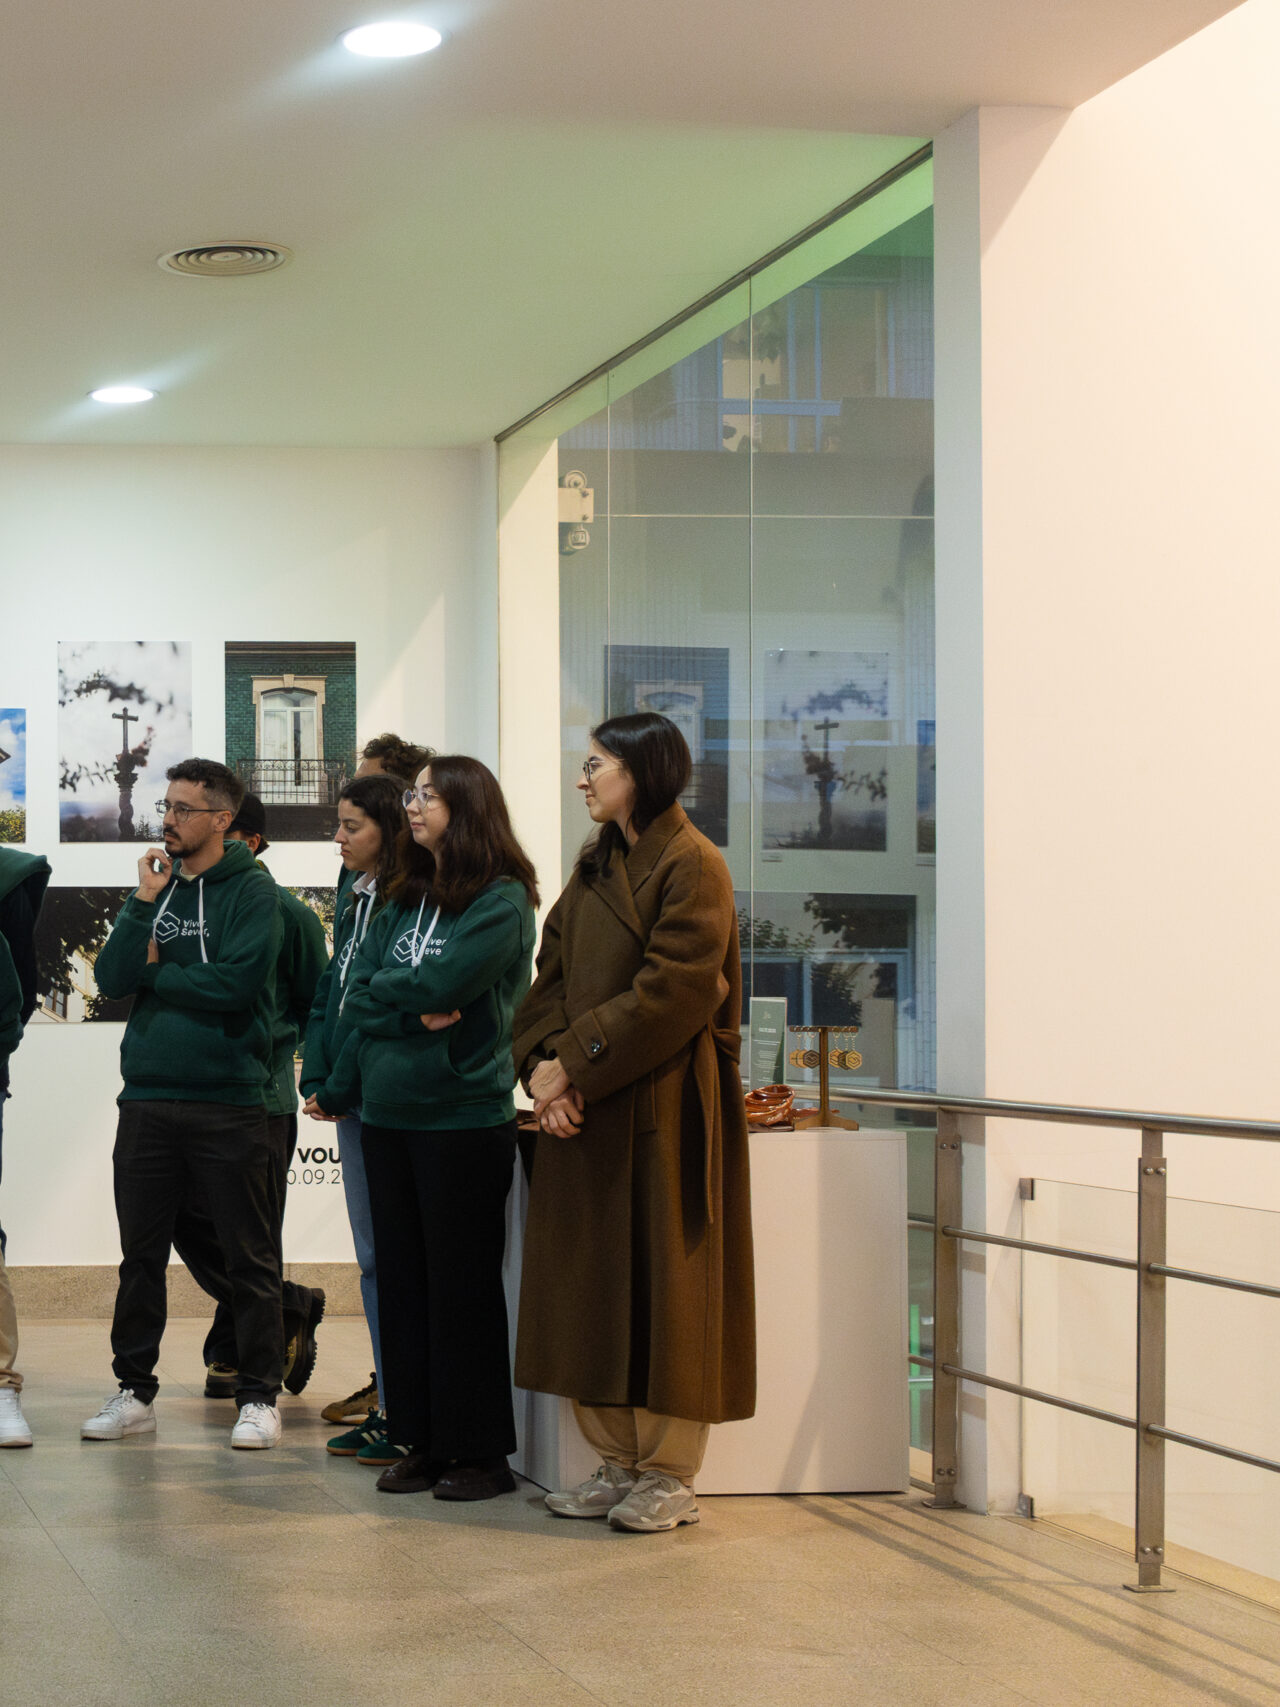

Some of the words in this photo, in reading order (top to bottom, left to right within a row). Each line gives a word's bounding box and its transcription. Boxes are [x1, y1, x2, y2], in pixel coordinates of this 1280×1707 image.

[428, 936, 447, 946] iver
[424, 947, 442, 956] eve
[297, 1147, 341, 1164] VOU
[286, 1168, 341, 1185] 0.09.2
